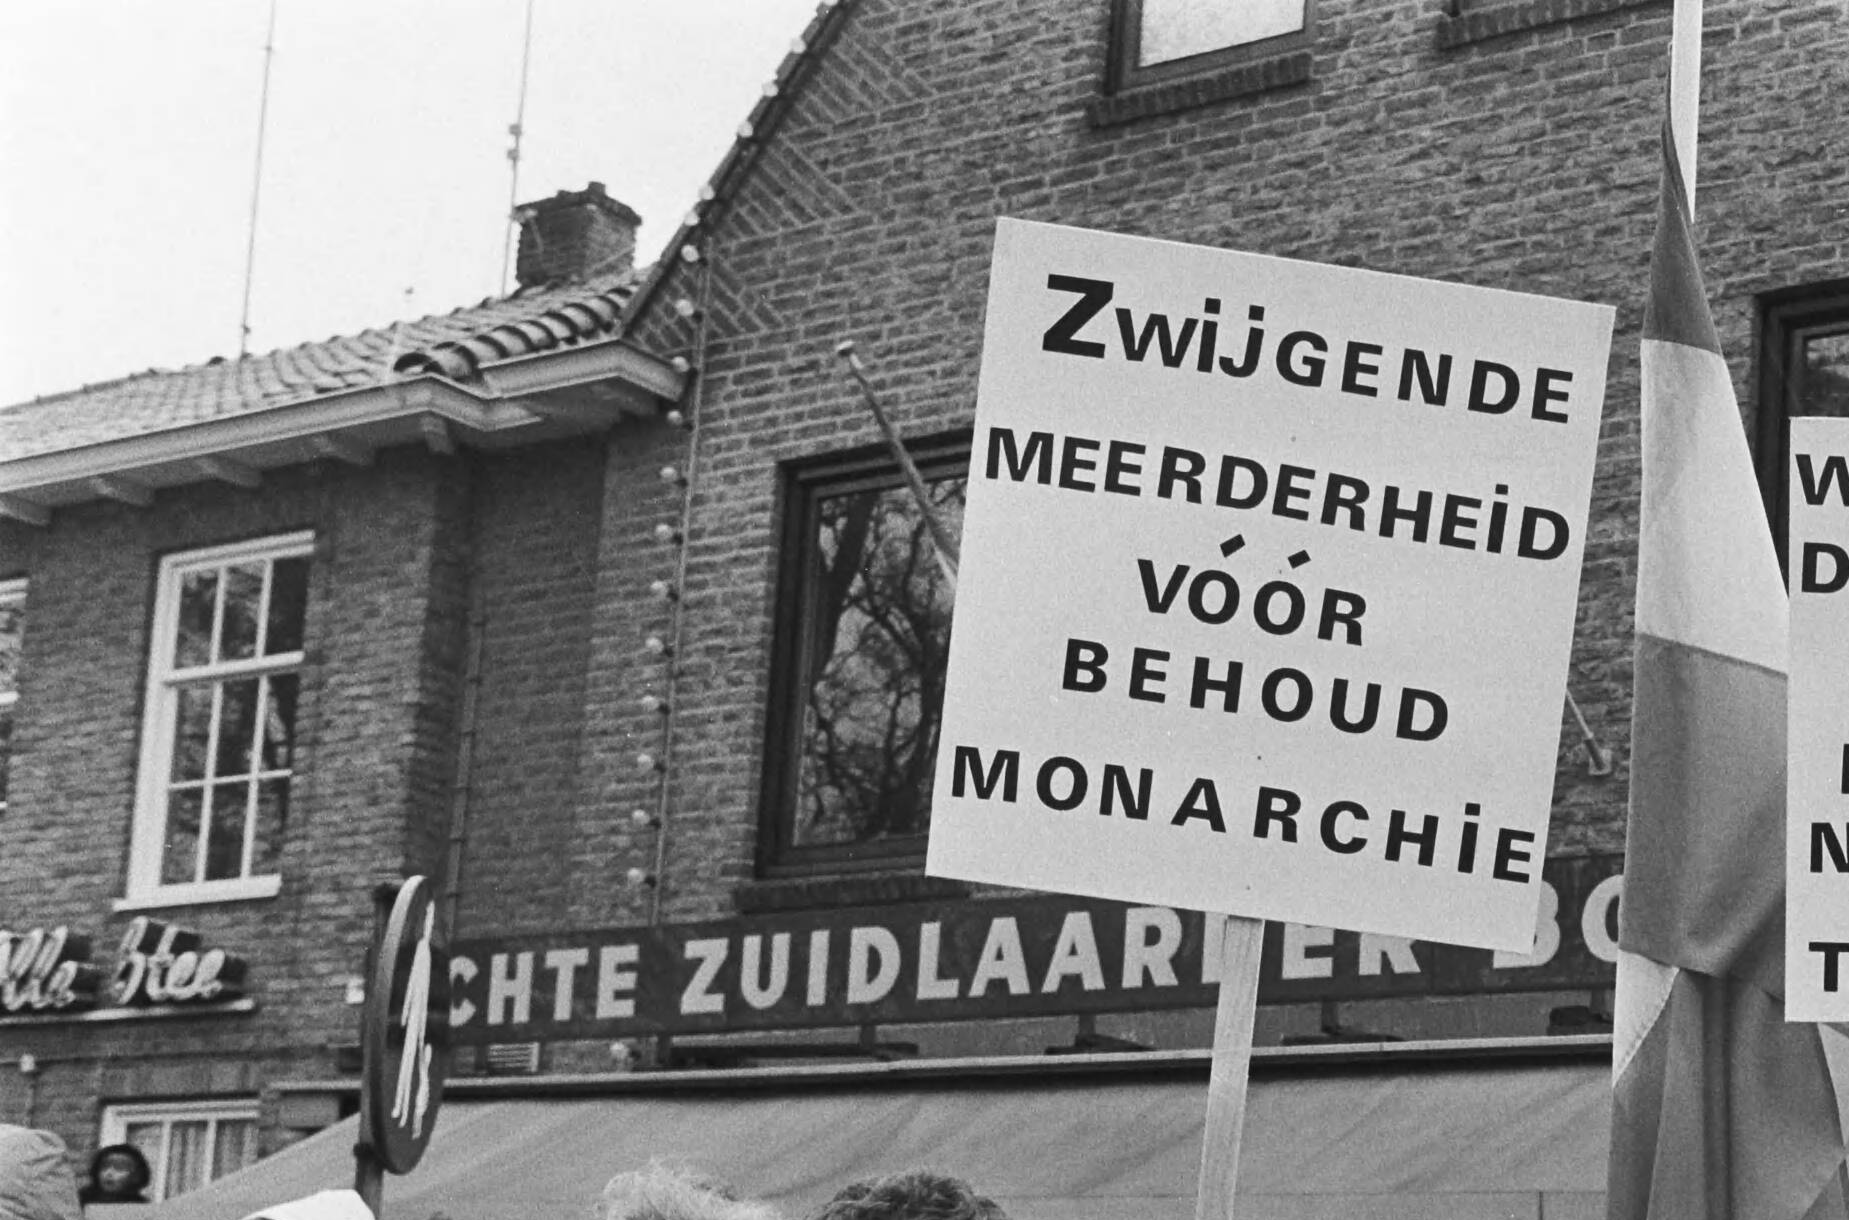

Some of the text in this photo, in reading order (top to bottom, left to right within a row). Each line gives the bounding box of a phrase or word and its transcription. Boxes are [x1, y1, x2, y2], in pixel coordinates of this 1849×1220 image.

[1137, 534, 1368, 647] VÓÓR
[1062, 638, 1448, 742] BEHOUD
[448, 943, 641, 1028] CHTE
[679, 905, 1423, 1015] ZUIDLAARE
